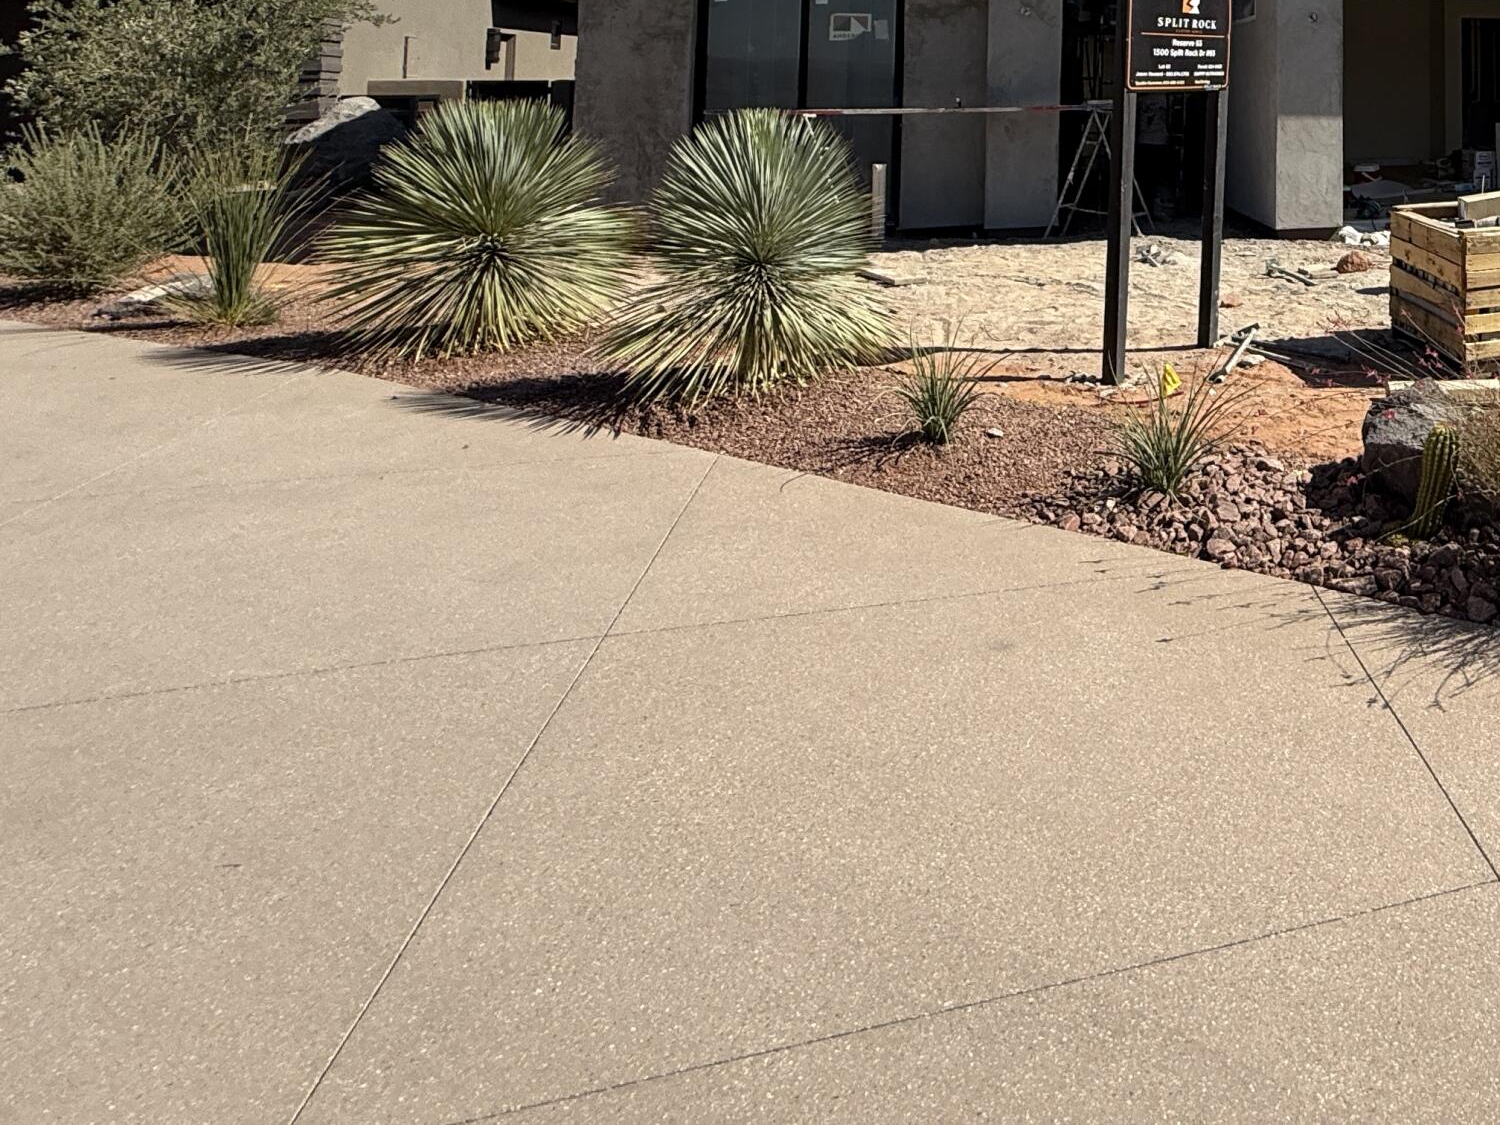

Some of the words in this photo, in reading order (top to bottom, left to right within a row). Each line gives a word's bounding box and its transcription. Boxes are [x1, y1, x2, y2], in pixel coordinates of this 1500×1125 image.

[1157, 17, 1190, 28] SPLIT
[1191, 19, 1217, 29] ROCK
[1172, 39, 1195, 47] Reserve
[1153, 48, 1169, 56] 1500
[1170, 49, 1184, 57] Split
[1184, 49, 1198, 57] Rock
